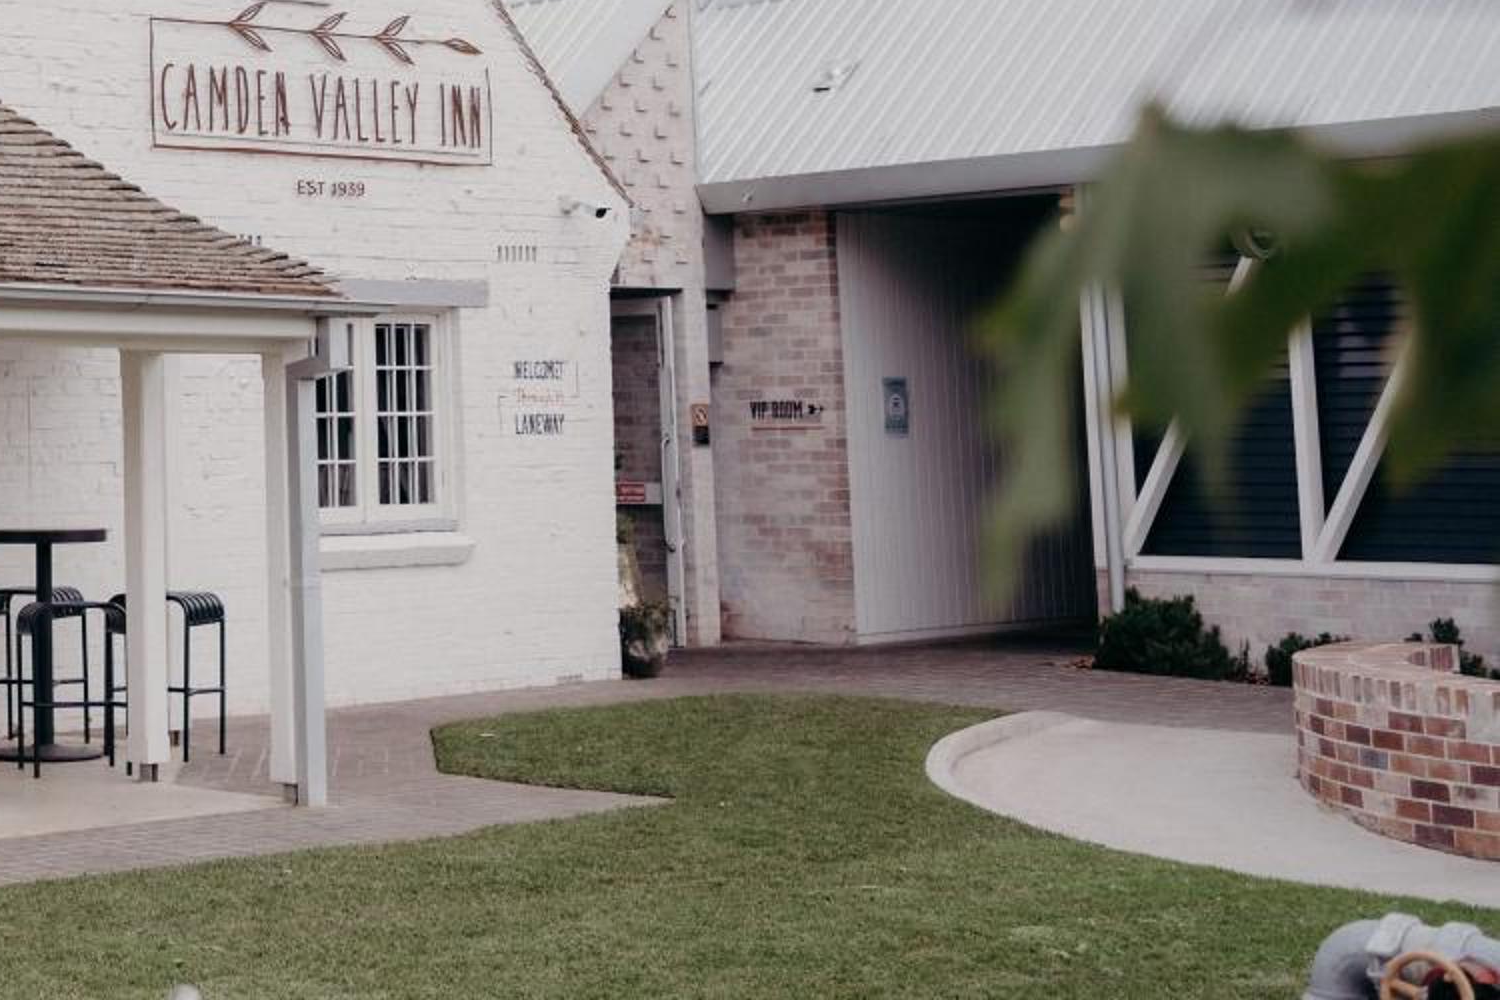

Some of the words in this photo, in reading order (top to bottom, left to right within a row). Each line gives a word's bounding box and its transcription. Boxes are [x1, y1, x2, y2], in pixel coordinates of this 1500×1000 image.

[160, 63, 291, 137] CAMDEN
[310, 72, 420, 145] VALLEY
[439, 83, 482, 149] INN
[297, 179, 325, 196] EST
[331, 181, 365, 197] 1939
[750, 401, 768, 420] VIP
[772, 401, 803, 419] ROOM
[515, 413, 565, 435] LANEWAY
